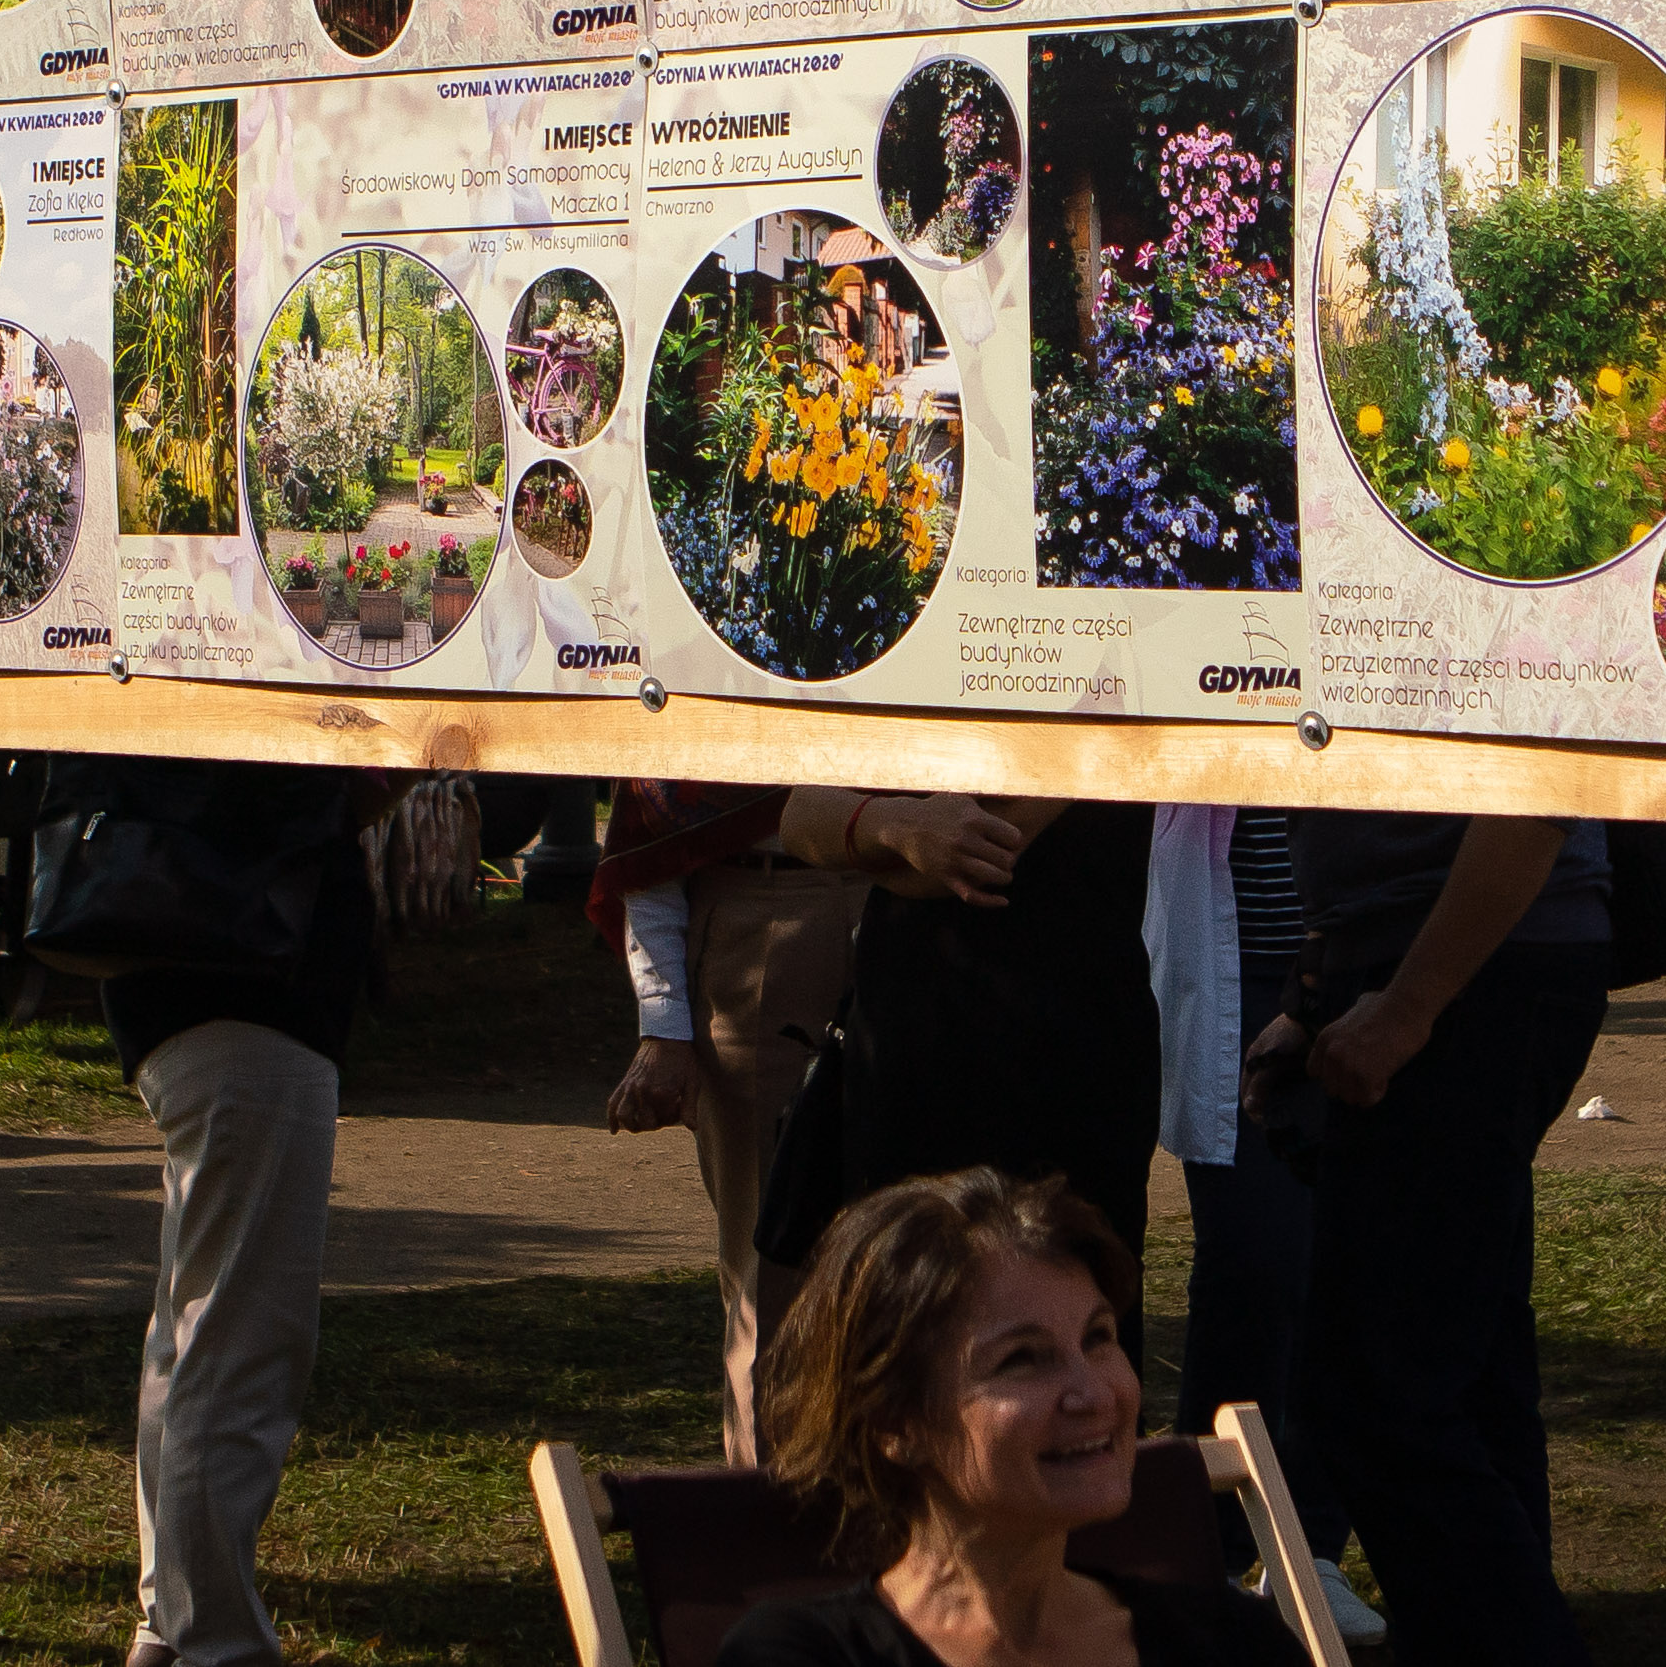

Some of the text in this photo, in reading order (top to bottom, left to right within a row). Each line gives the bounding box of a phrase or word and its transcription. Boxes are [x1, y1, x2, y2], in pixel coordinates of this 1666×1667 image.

[552, 5, 637, 37] GDYNIA
[655, 3, 740, 31] budynków
[120, 21, 237, 48] Nadziemne części
[40, 47, 109, 76] GDYNIA
[122, 39, 307, 74] budynków wielorodzinnych
[709, 63, 725, 80] W
[728, 59, 800, 78] KWIATACH
[803, 54, 844, 72] 2020'
[437, 70, 634, 99] 'GDYNIA W KWIATACH 2020'
[8, 112, 70, 132] KWIATACH
[72, 109, 108, 128] 2020'
[652, 111, 790, 144] WYRÓŻNIENIE
[554, 123, 632, 153] MIEJSCE
[40, 158, 104, 186] MIEJSCE
[649, 147, 862, 178] Helena & Jerzy Augustyn
[341, 160, 631, 195] Środowiskowy Dom Samopomocy
[28, 189, 104, 217] Zofia Klęka
[551, 192, 629, 215] Maczka 1
[646, 199, 713, 216] Chwarzno
[54, 228, 103, 242] Redłowo
[468, 231, 628, 256] Wzg. Św. Maksymiliana
[121, 581, 194, 604] Zewnętrzne
[123, 611, 238, 635] części budynków
[958, 612, 1132, 641] Zewnętrzne części
[1320, 614, 1434, 642] Zewnętrzne
[43, 626, 112, 649] GDYNIA
[125, 640, 167, 663] użytku
[171, 643, 253, 665] publicznego
[558, 643, 641, 670] GDYNIA
[960, 641, 1062, 669] budynków
[587, 666, 642, 681] moje miasto
[1199, 665, 1301, 693] GDYNIA
[1322, 653, 1637, 688] przyziemne części budynków
[960, 671, 1126, 700] jednorodzinnych
[1237, 692, 1301, 707] moje miasto
[1323, 684, 1492, 715] wielorodzinnych
